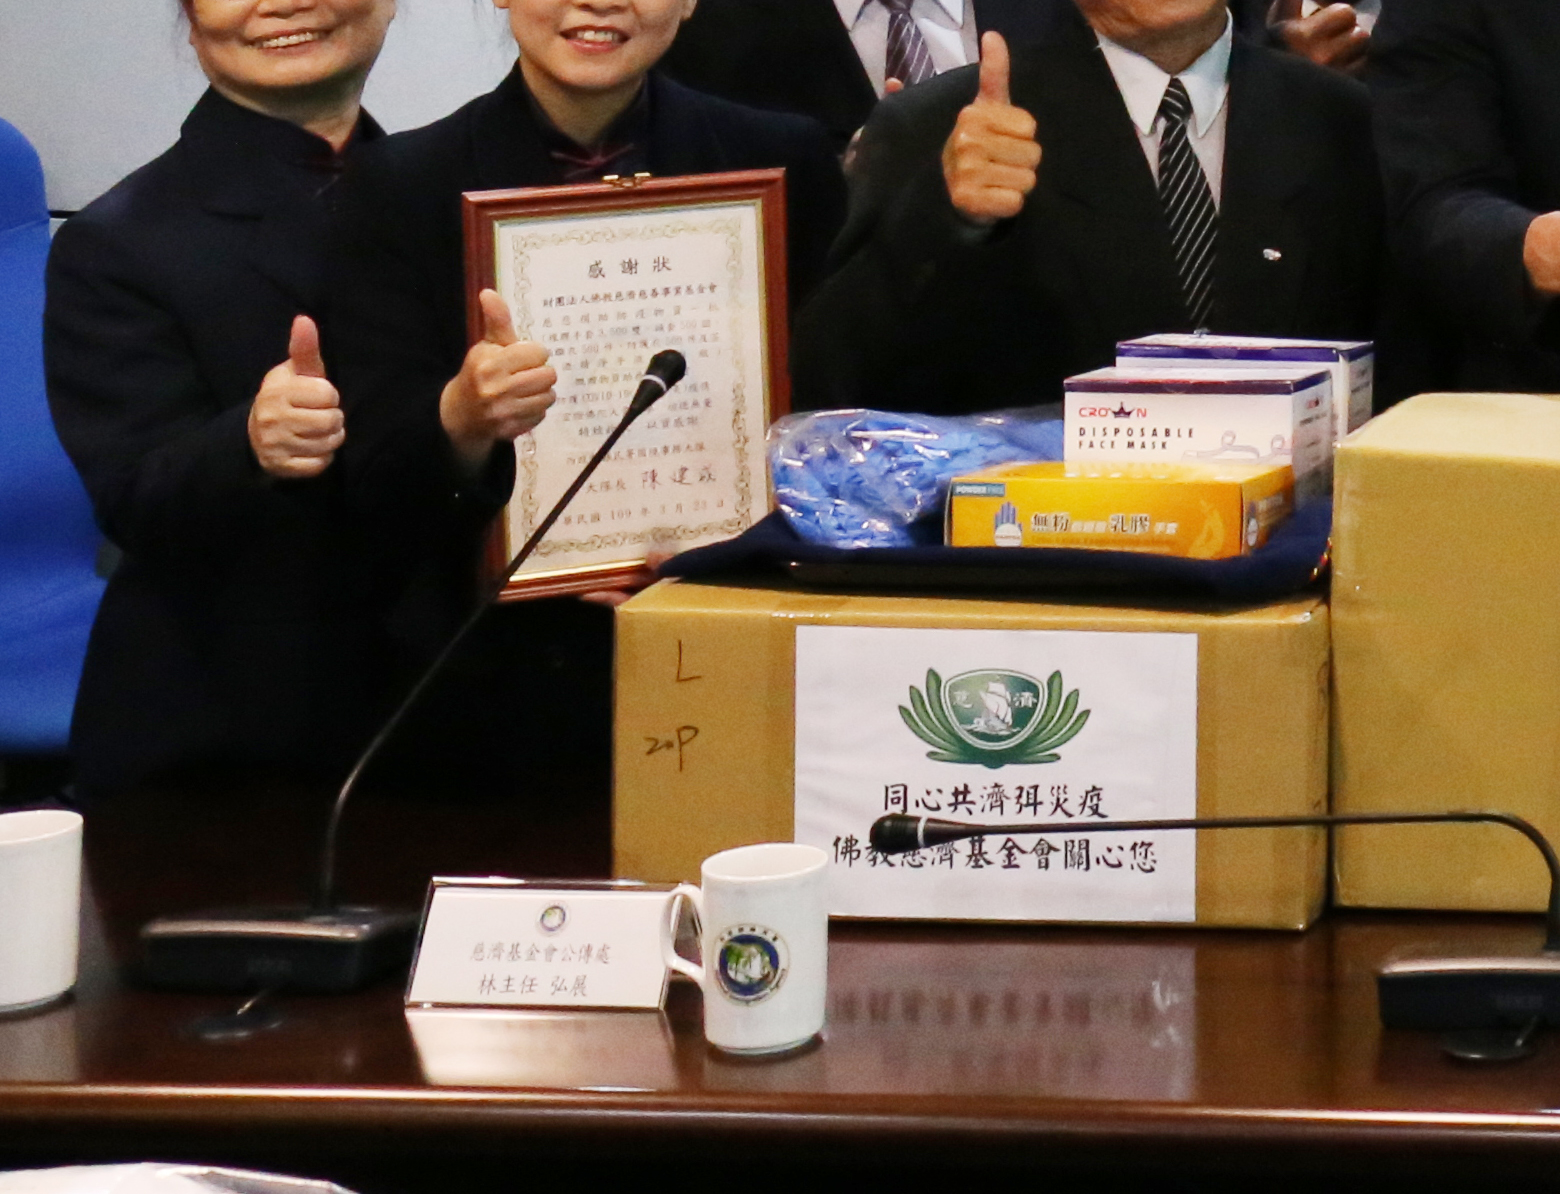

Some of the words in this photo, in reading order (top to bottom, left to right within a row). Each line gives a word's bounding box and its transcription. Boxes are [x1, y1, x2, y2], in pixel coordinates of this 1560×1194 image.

[588, 255, 672, 279] 感謝狀
[1079, 427, 1194, 438] DISPOSABLE
[1079, 440, 1116, 450] FACE
[1127, 440, 1167, 450] MASK
[676, 639, 702, 682] L
[884, 782, 1109, 819] 同心共濟弭災疫
[471, 940, 612, 964] 慈濟基金會公傳處
[478, 973, 539, 995] 林主任
